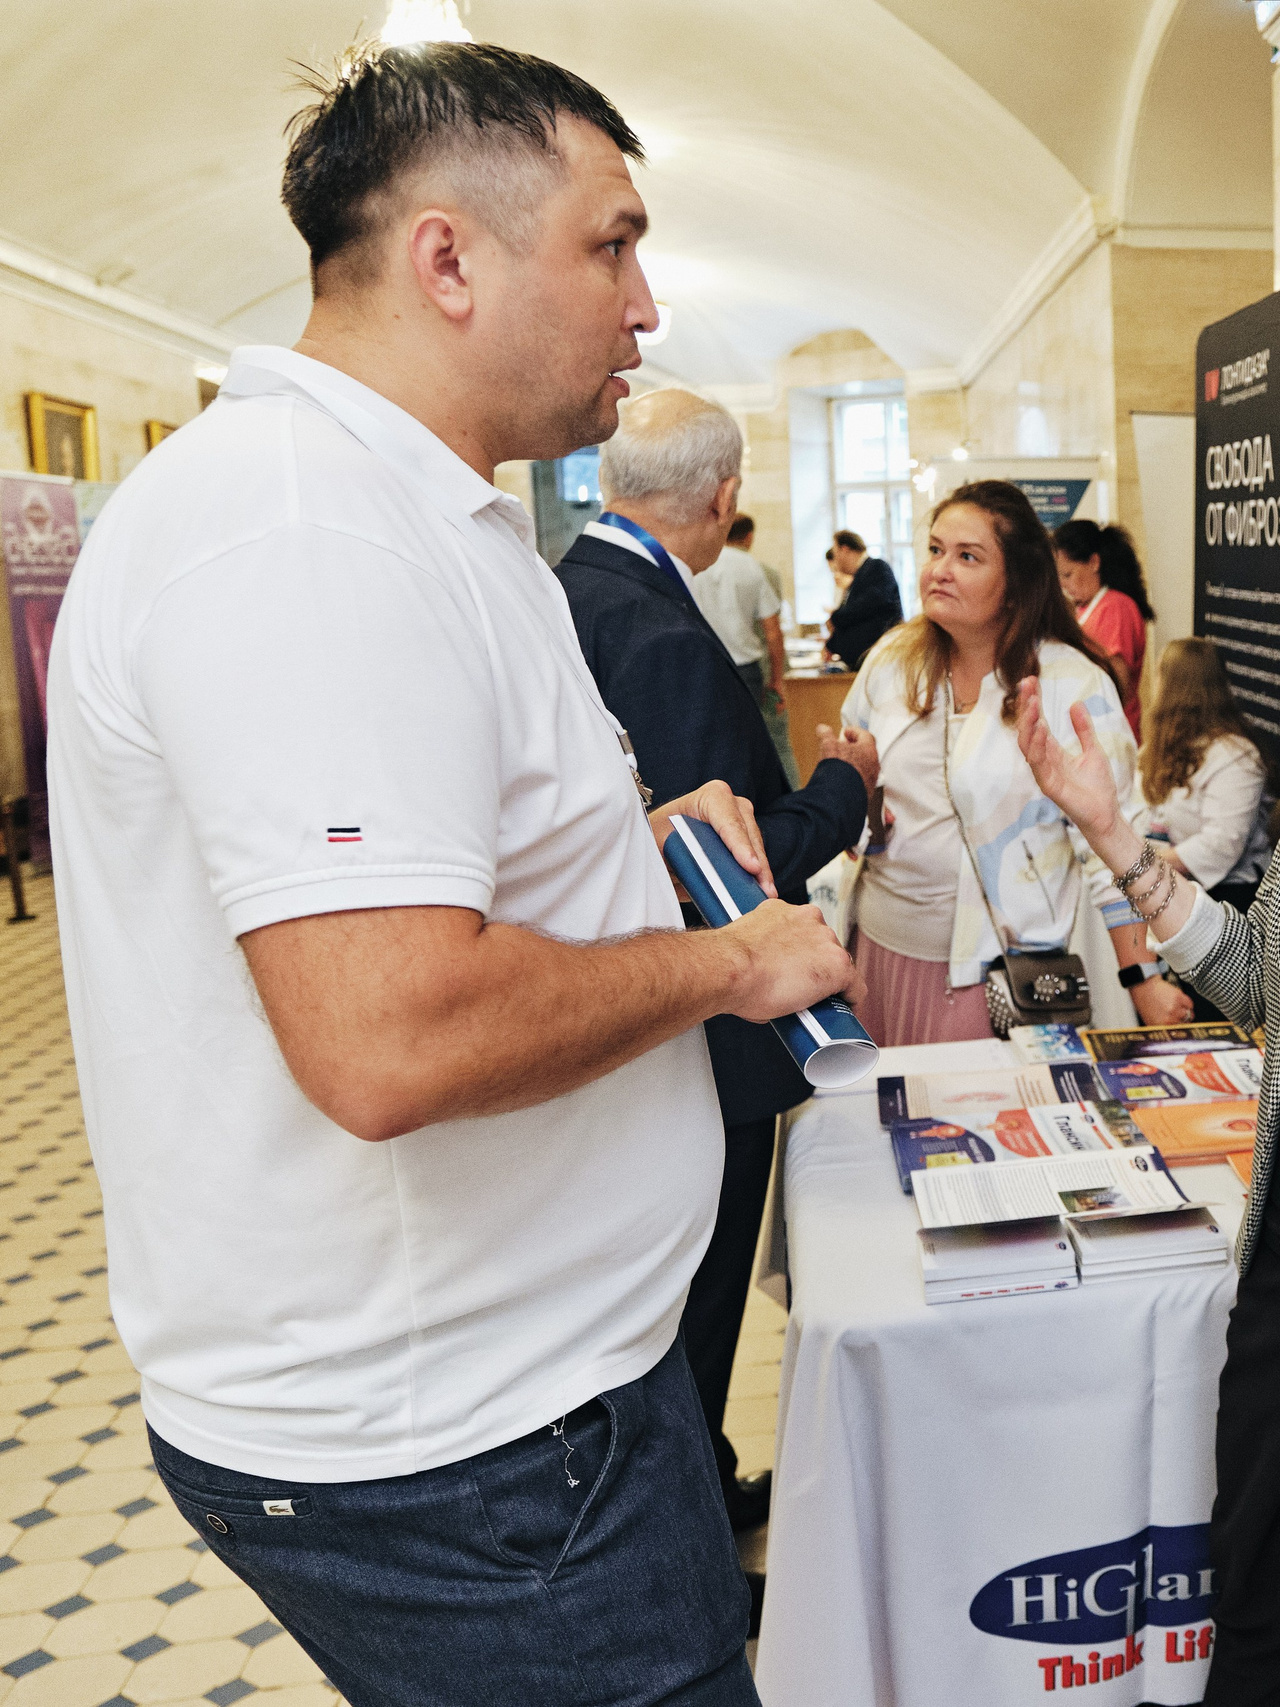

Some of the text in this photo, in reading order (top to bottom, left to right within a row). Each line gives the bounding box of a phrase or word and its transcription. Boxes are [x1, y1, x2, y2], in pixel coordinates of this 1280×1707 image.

[1205, 434, 1275, 492] СВОБОДА
[1205, 501, 1226, 547] ОТ
[1038, 1626, 1214, 1691] Think Lif
